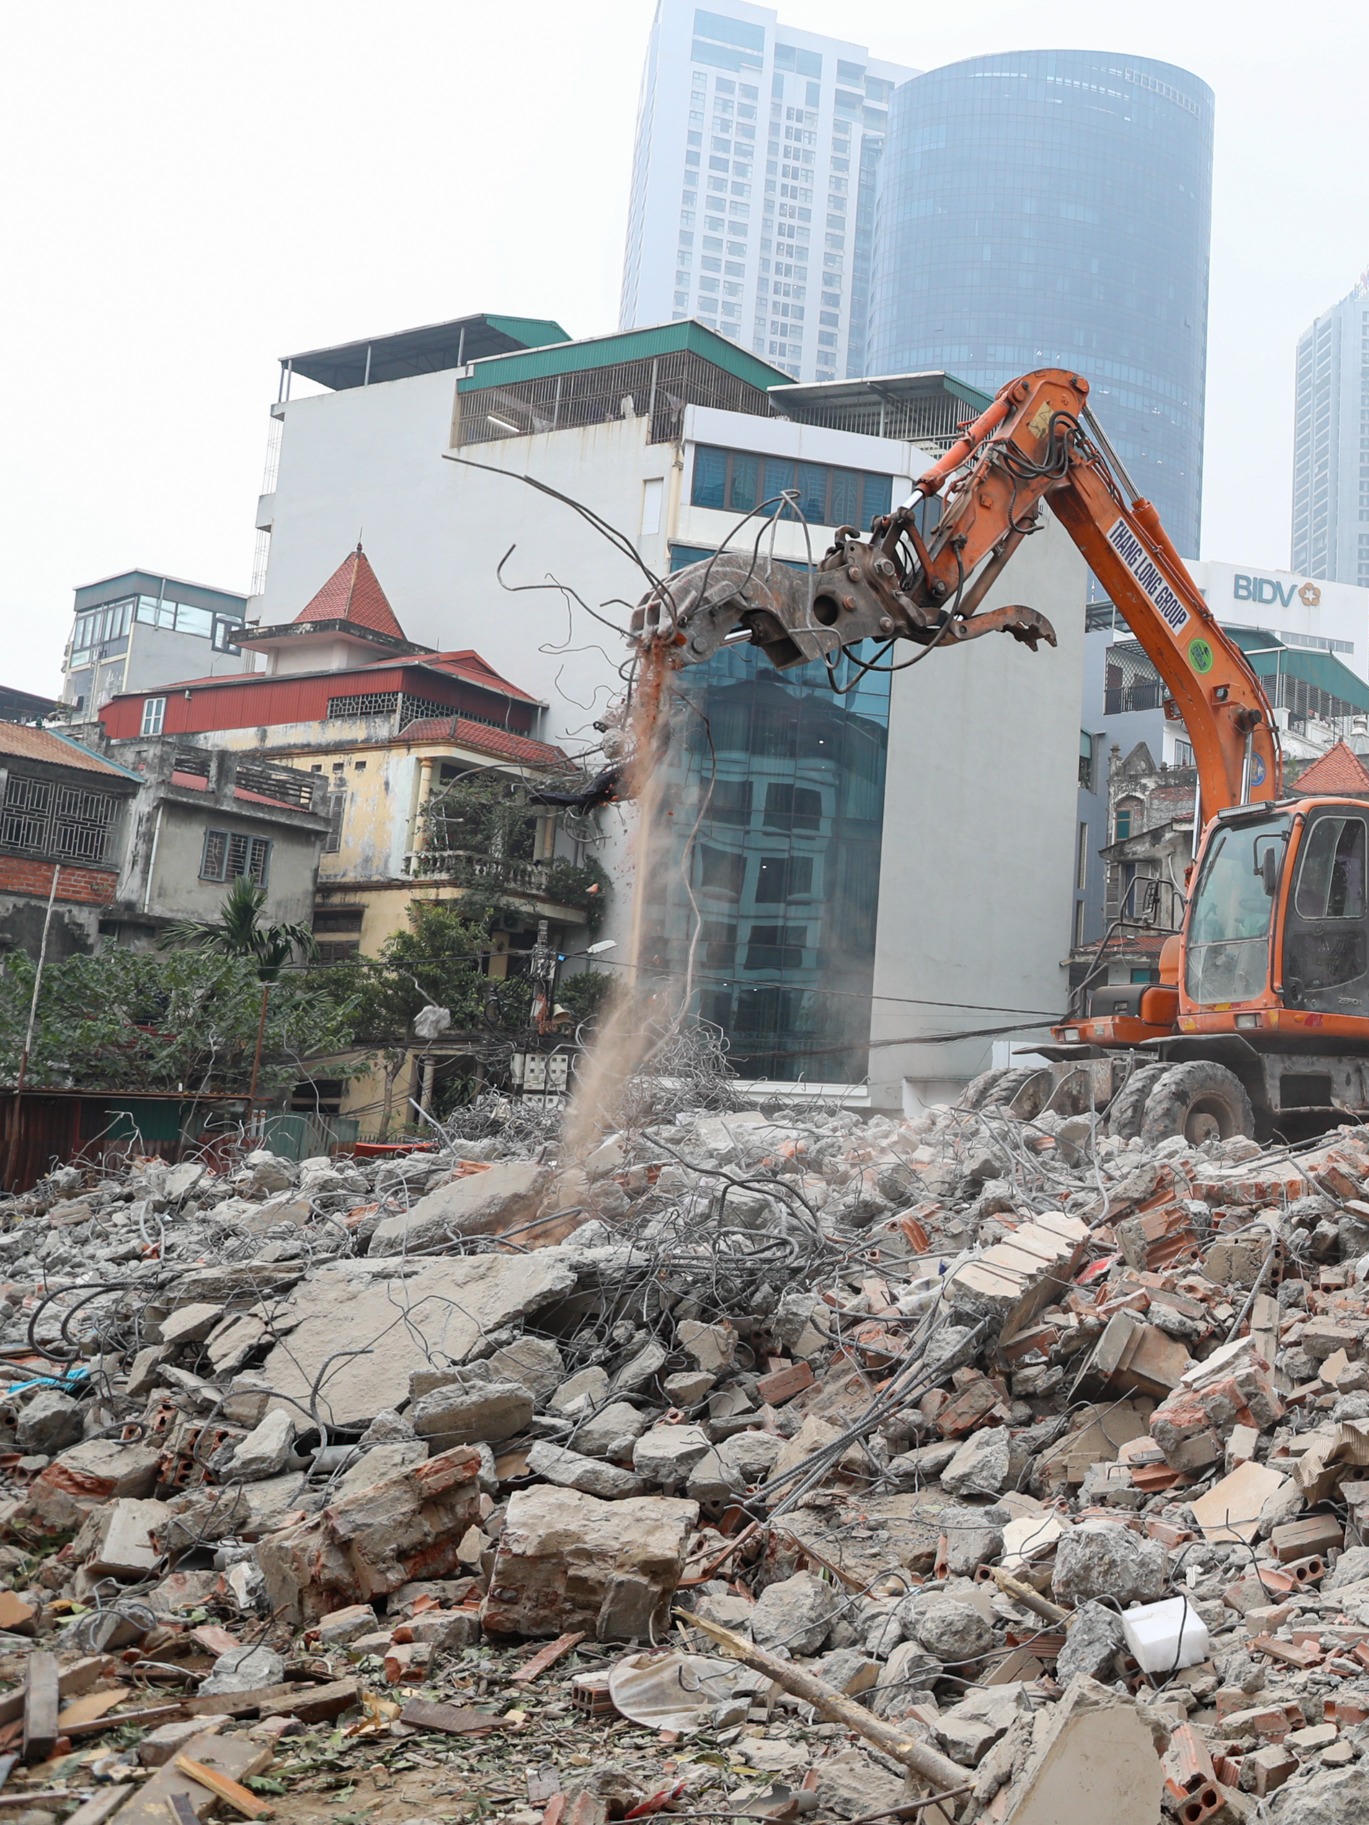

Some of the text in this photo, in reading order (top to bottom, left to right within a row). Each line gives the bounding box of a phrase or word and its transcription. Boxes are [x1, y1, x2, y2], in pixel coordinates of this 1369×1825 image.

[1109, 520, 1188, 629] THANG LONG GROUP
[1234, 574, 1298, 608] BIDV
